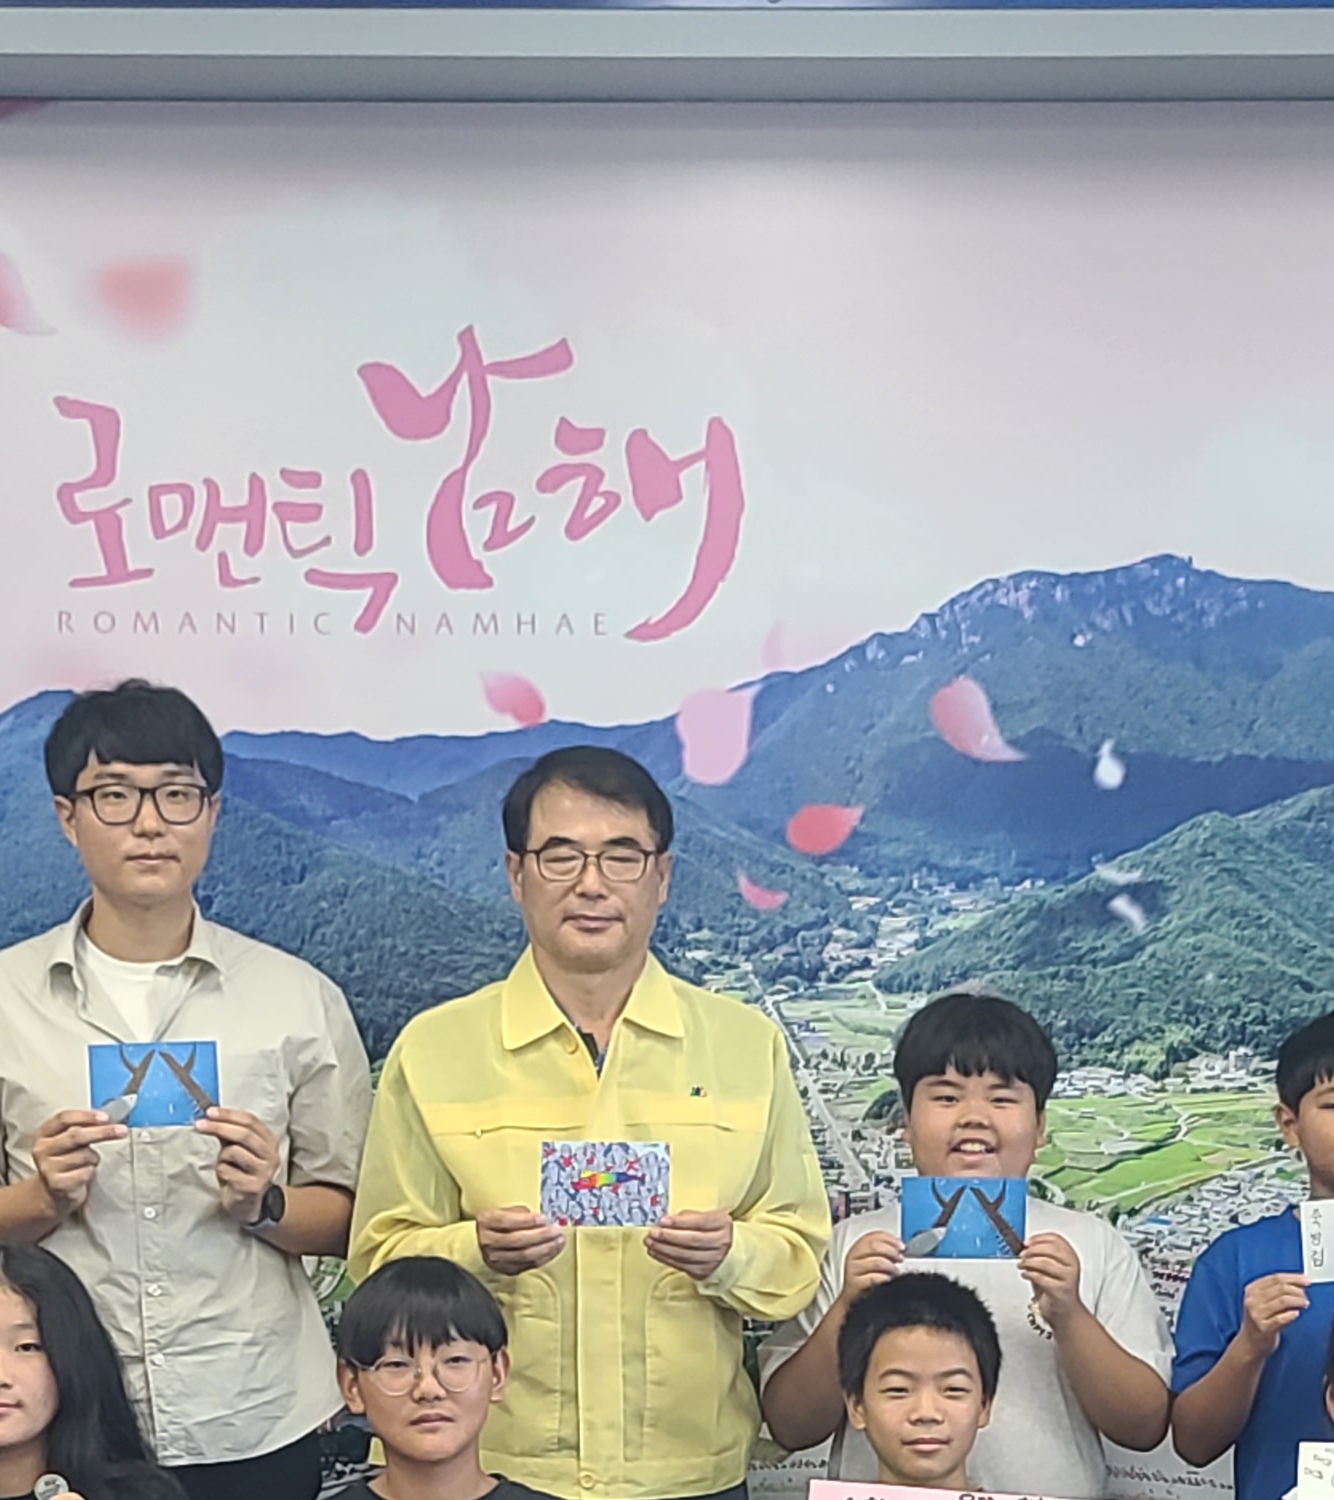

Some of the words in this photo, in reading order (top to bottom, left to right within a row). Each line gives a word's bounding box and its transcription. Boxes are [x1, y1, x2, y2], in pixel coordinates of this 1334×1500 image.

[53, 394, 399, 636] 로맨틱
[355, 323, 746, 643] 남해
[56, 610, 334, 636] ROMANTIC
[396, 610, 610, 637] NAMHAE
